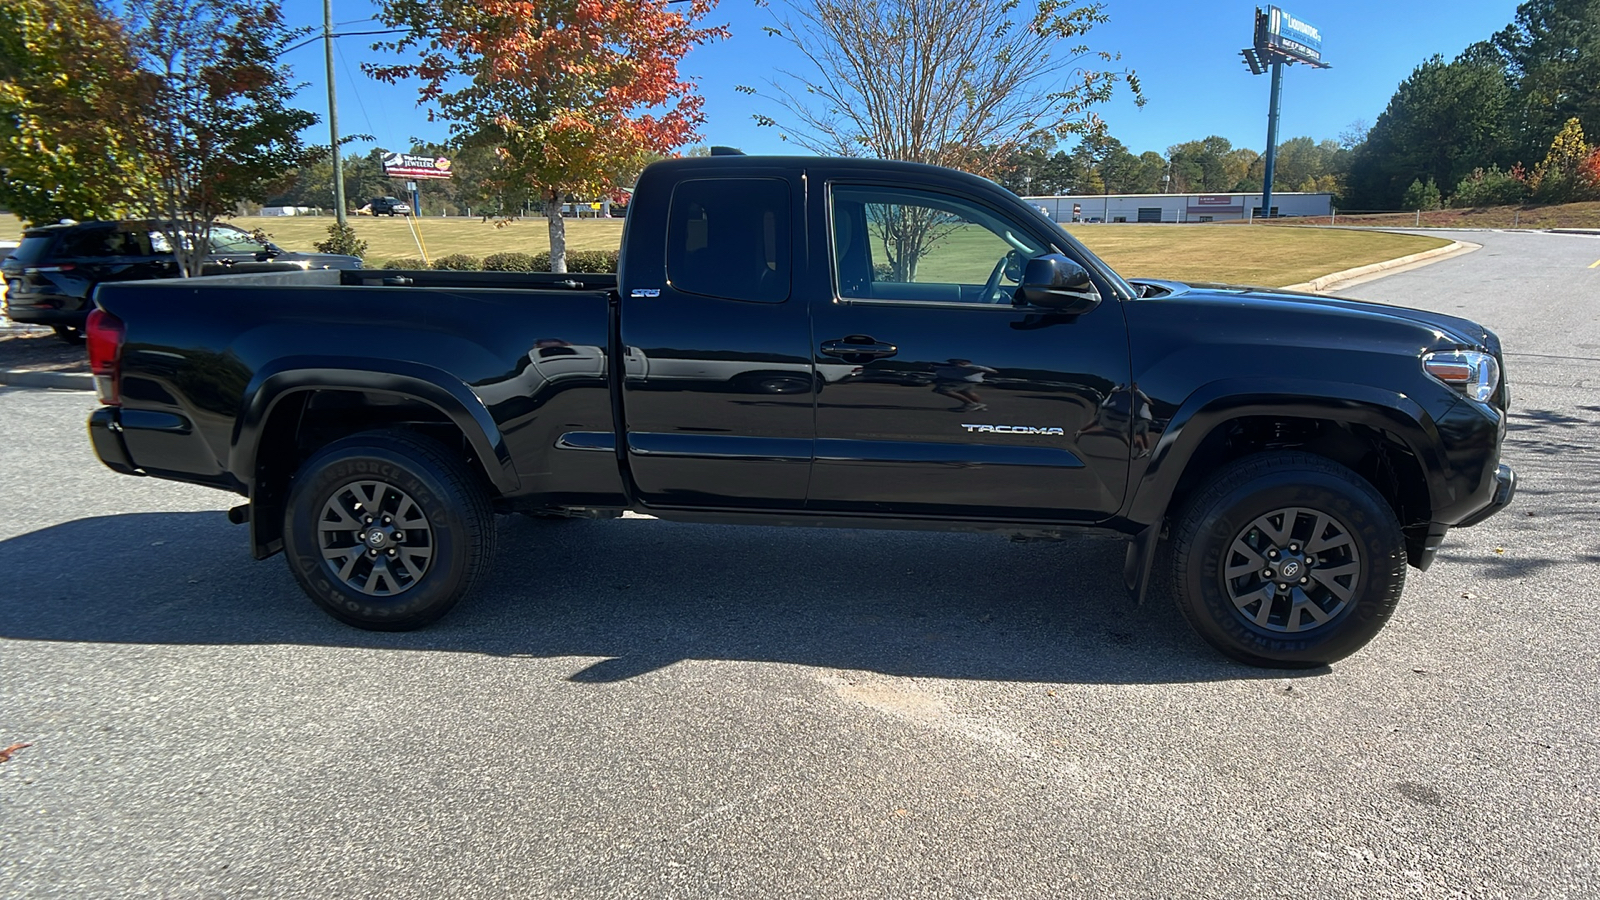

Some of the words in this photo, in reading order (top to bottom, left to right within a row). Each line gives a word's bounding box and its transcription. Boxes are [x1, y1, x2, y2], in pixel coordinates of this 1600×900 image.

[404, 160, 434, 168] JEWELERS
[630, 288, 661, 298] SR5
[960, 423, 1065, 436] TACOMA
